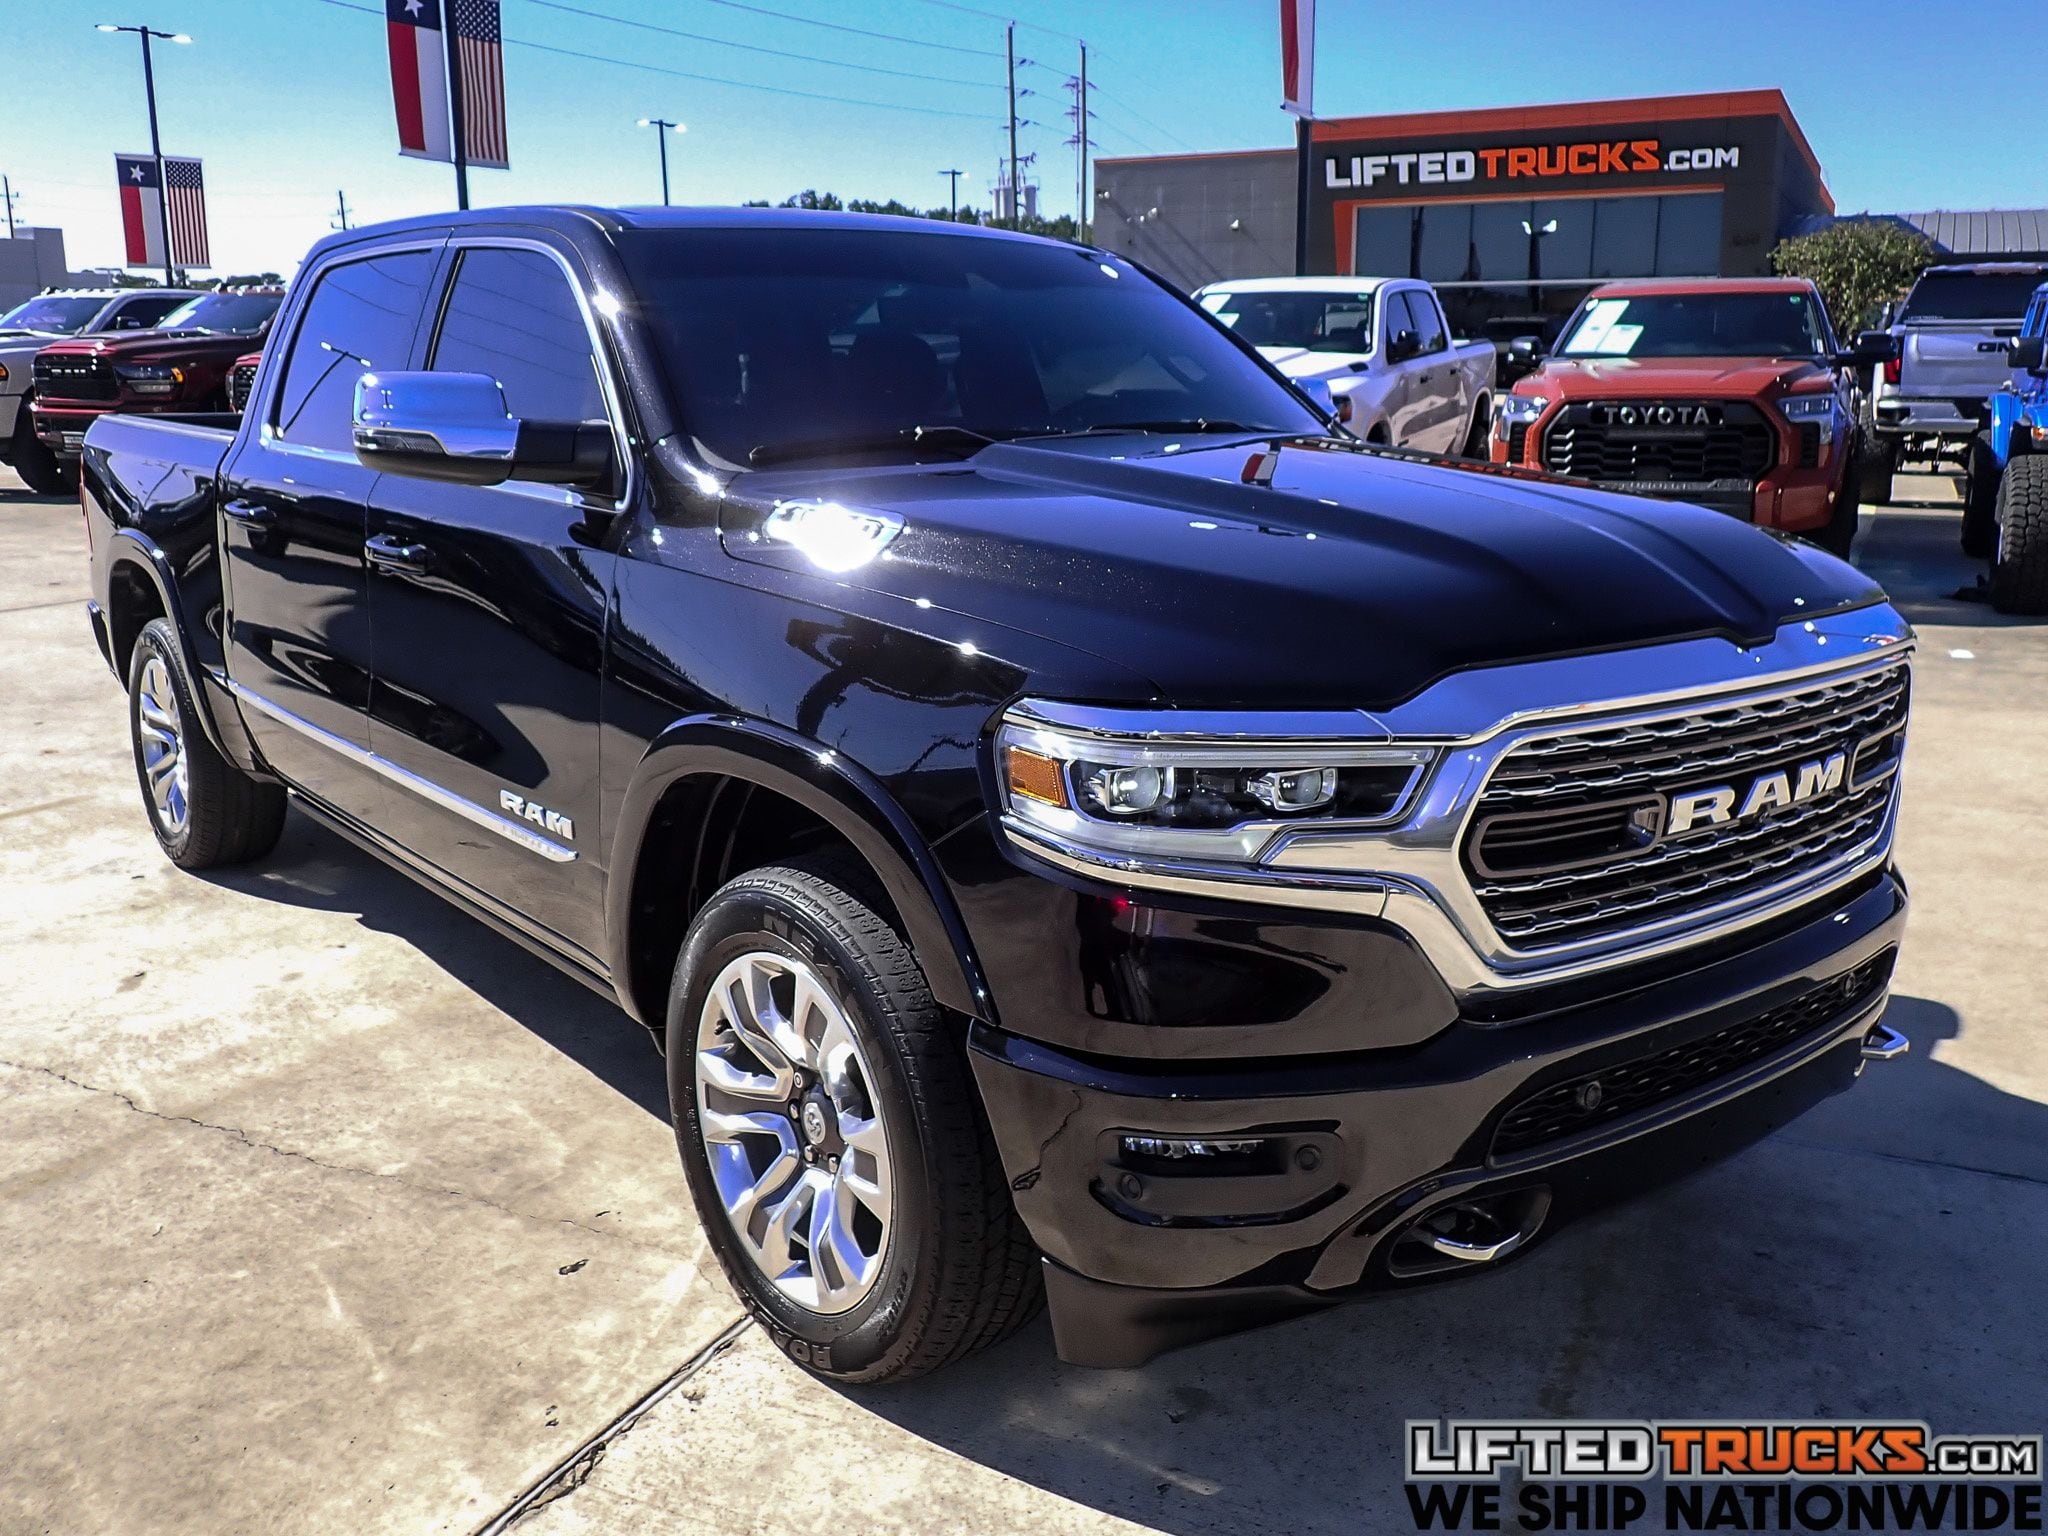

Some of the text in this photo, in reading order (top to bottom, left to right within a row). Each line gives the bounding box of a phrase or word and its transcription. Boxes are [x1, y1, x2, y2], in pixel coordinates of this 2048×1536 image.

[1603, 406, 1710, 425] TOYOTA
[500, 789, 576, 840] RAM
[1667, 751, 1846, 836] RAM
